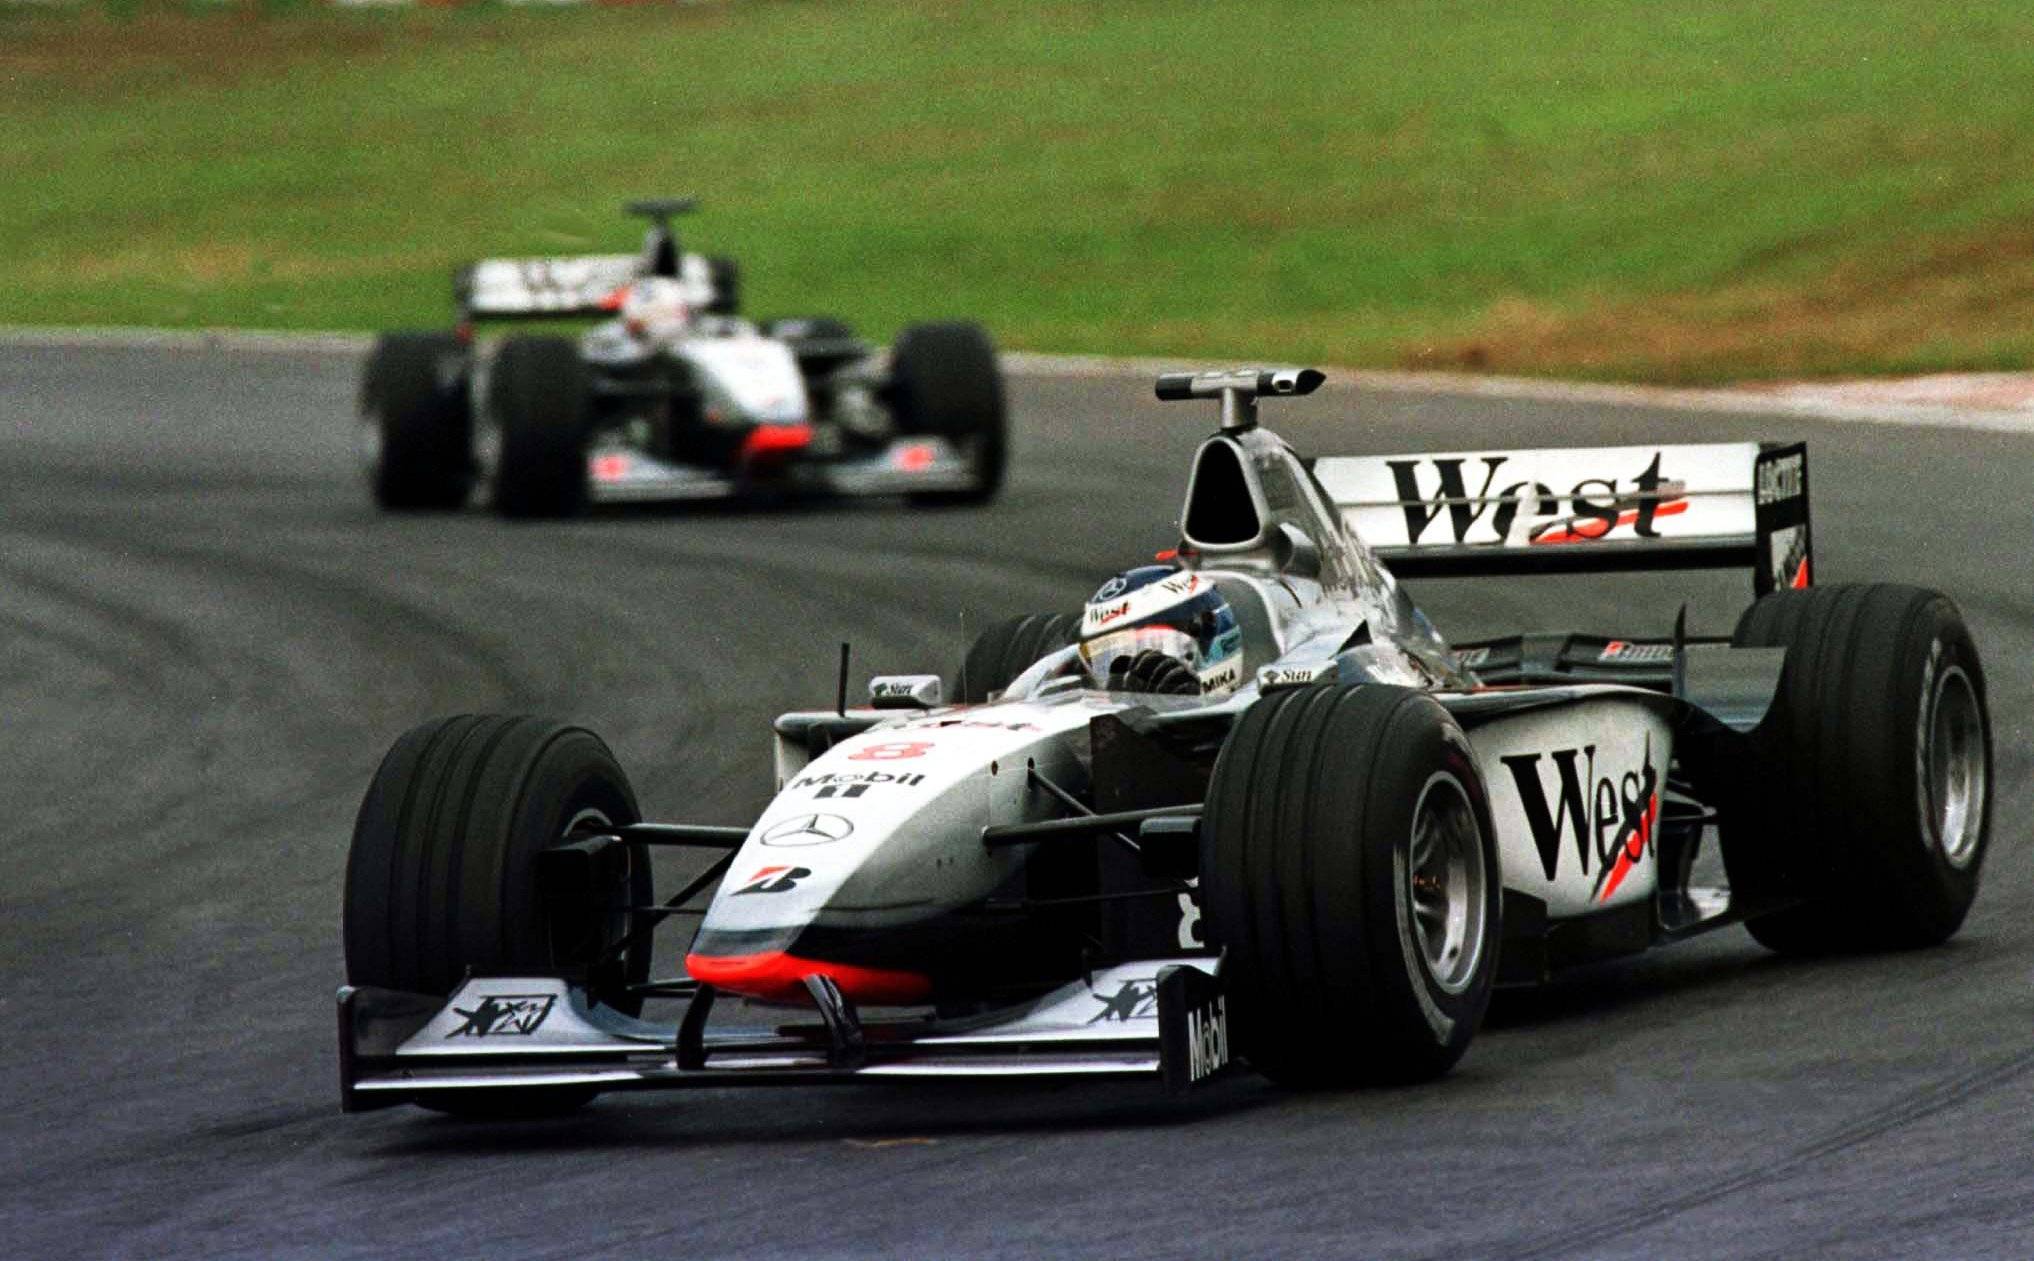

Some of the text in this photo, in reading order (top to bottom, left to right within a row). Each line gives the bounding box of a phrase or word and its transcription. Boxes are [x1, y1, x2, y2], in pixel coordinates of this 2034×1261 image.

[1385, 451, 1687, 545] West
[1202, 668, 1236, 694] MIKA
[791, 770, 926, 789] Mobil
[1500, 730, 1658, 903] West
[1187, 994, 1229, 1082] Mobil
